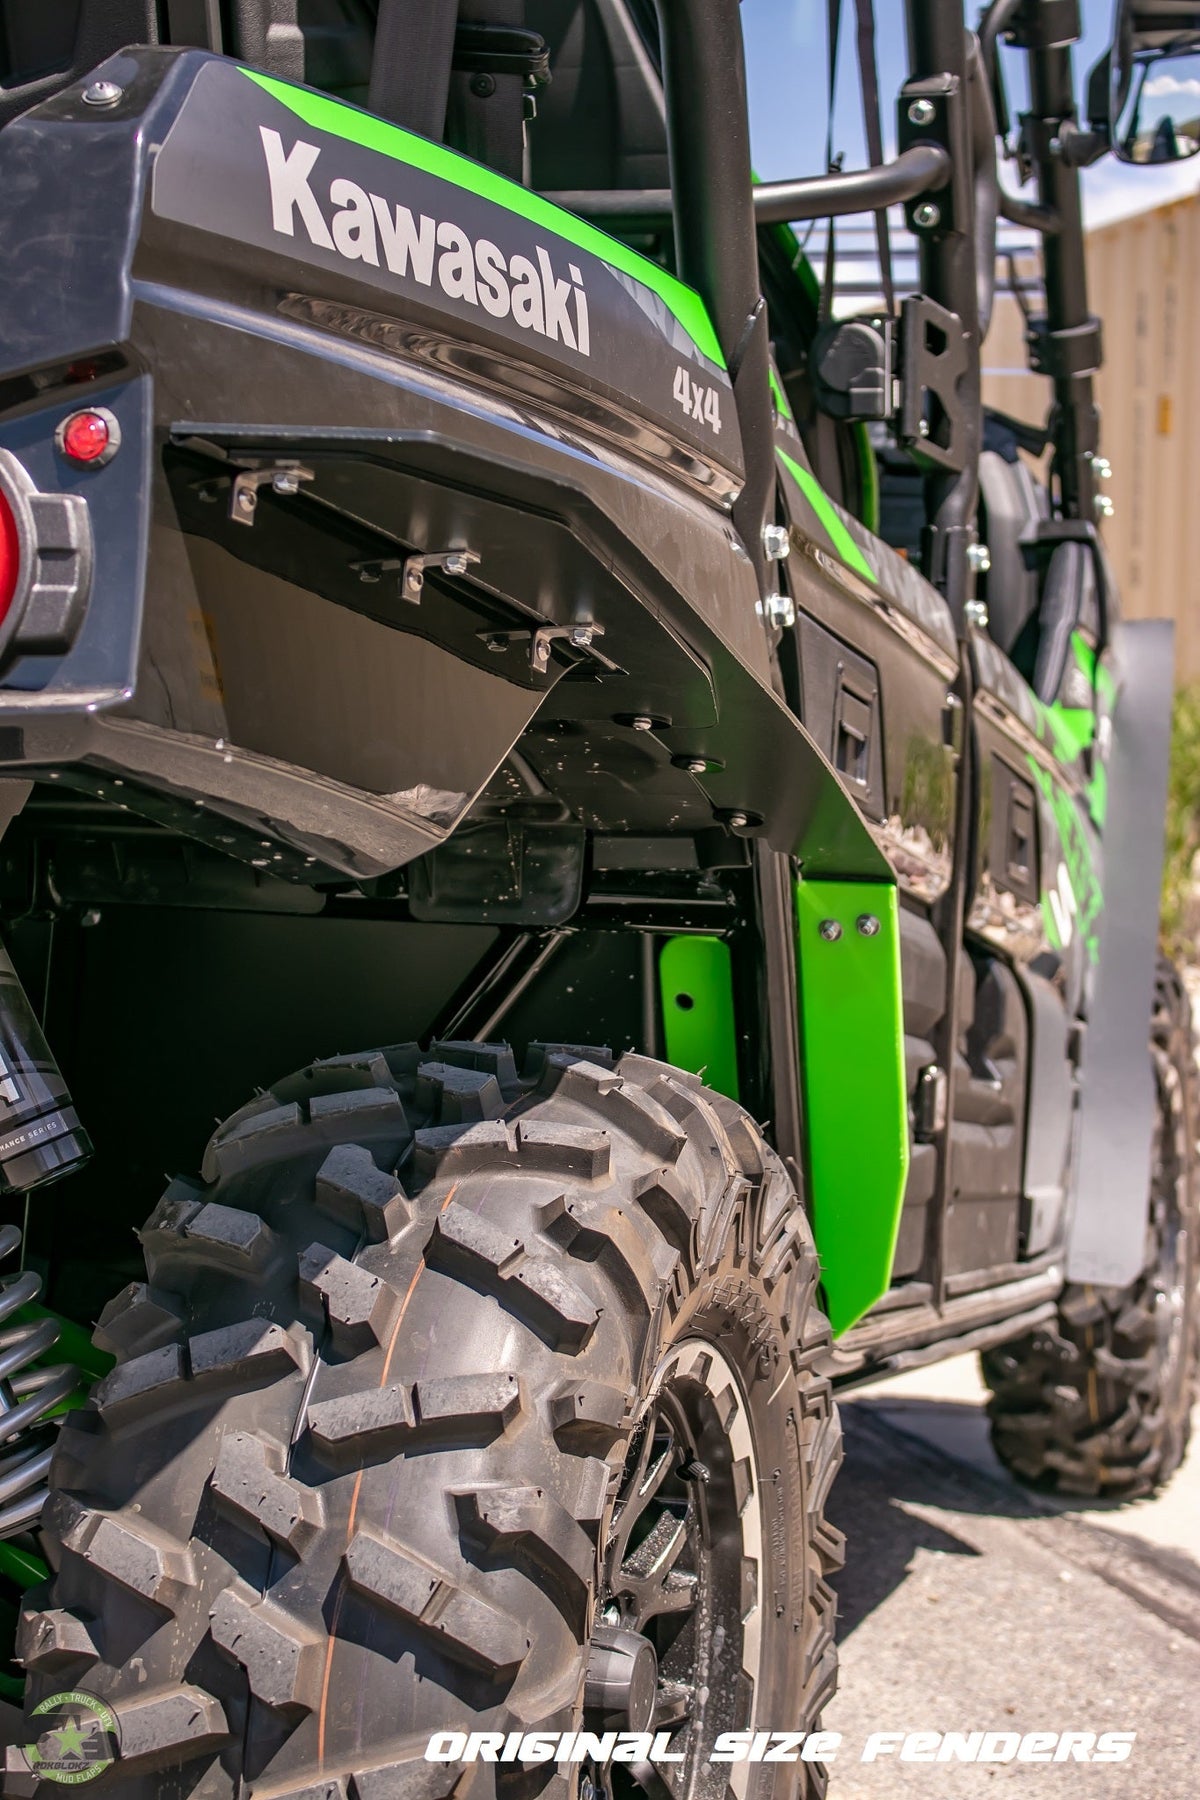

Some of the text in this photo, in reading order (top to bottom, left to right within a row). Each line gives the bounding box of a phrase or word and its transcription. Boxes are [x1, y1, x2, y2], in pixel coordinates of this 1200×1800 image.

[259, 126, 590, 357] Kawasaki
[673, 366, 722, 435] 4x4
[27, 1121, 58, 1139] SERIES
